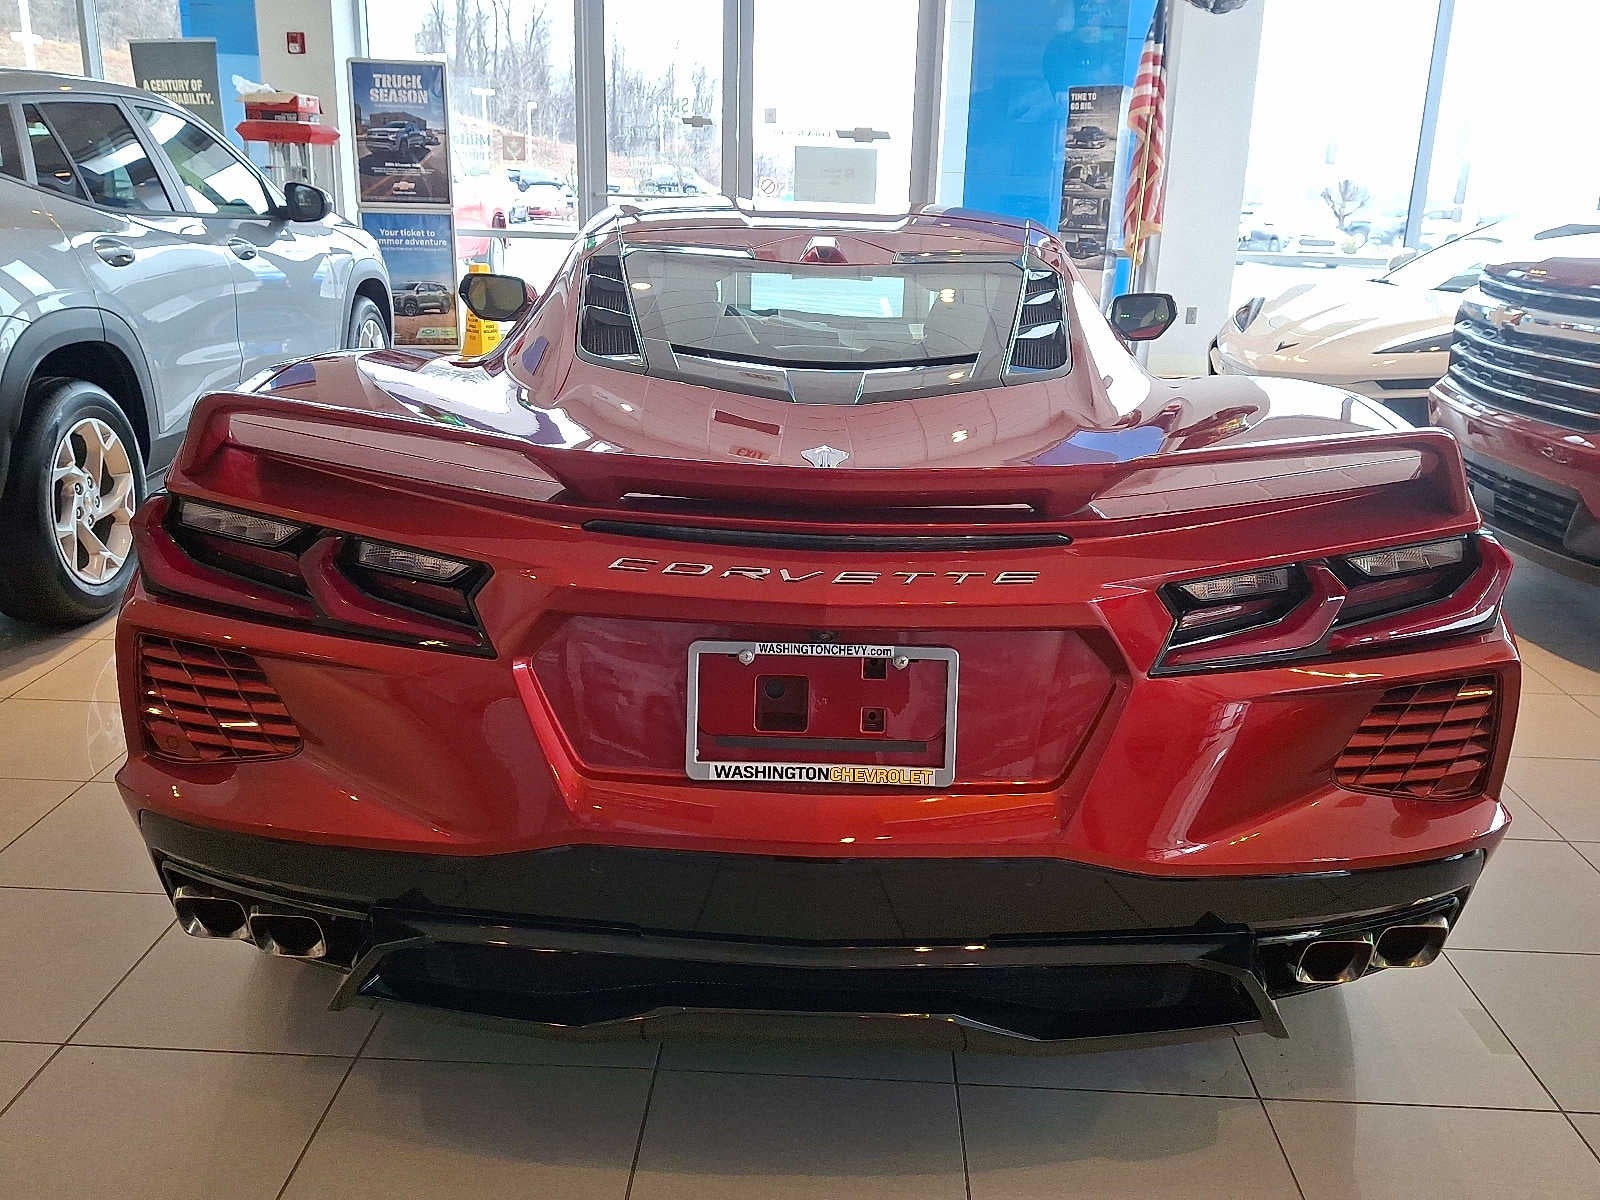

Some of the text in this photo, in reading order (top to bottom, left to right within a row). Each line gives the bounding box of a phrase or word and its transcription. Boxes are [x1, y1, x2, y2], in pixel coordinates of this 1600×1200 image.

[143, 79, 203, 91] A CENTURY OF
[372, 73, 422, 89] TRUCK
[369, 88, 428, 104] SEASON
[1088, 92, 1097, 101] TO
[379, 228, 399, 237] Your
[400, 229, 425, 237] ticket
[405, 238, 448, 246] adventure
[607, 556, 1041, 585] CORVETTE
[758, 643, 893, 657] WASHINGTONCHEVY.com
[713, 764, 934, 785] WASHINGTONCHEVROLET
